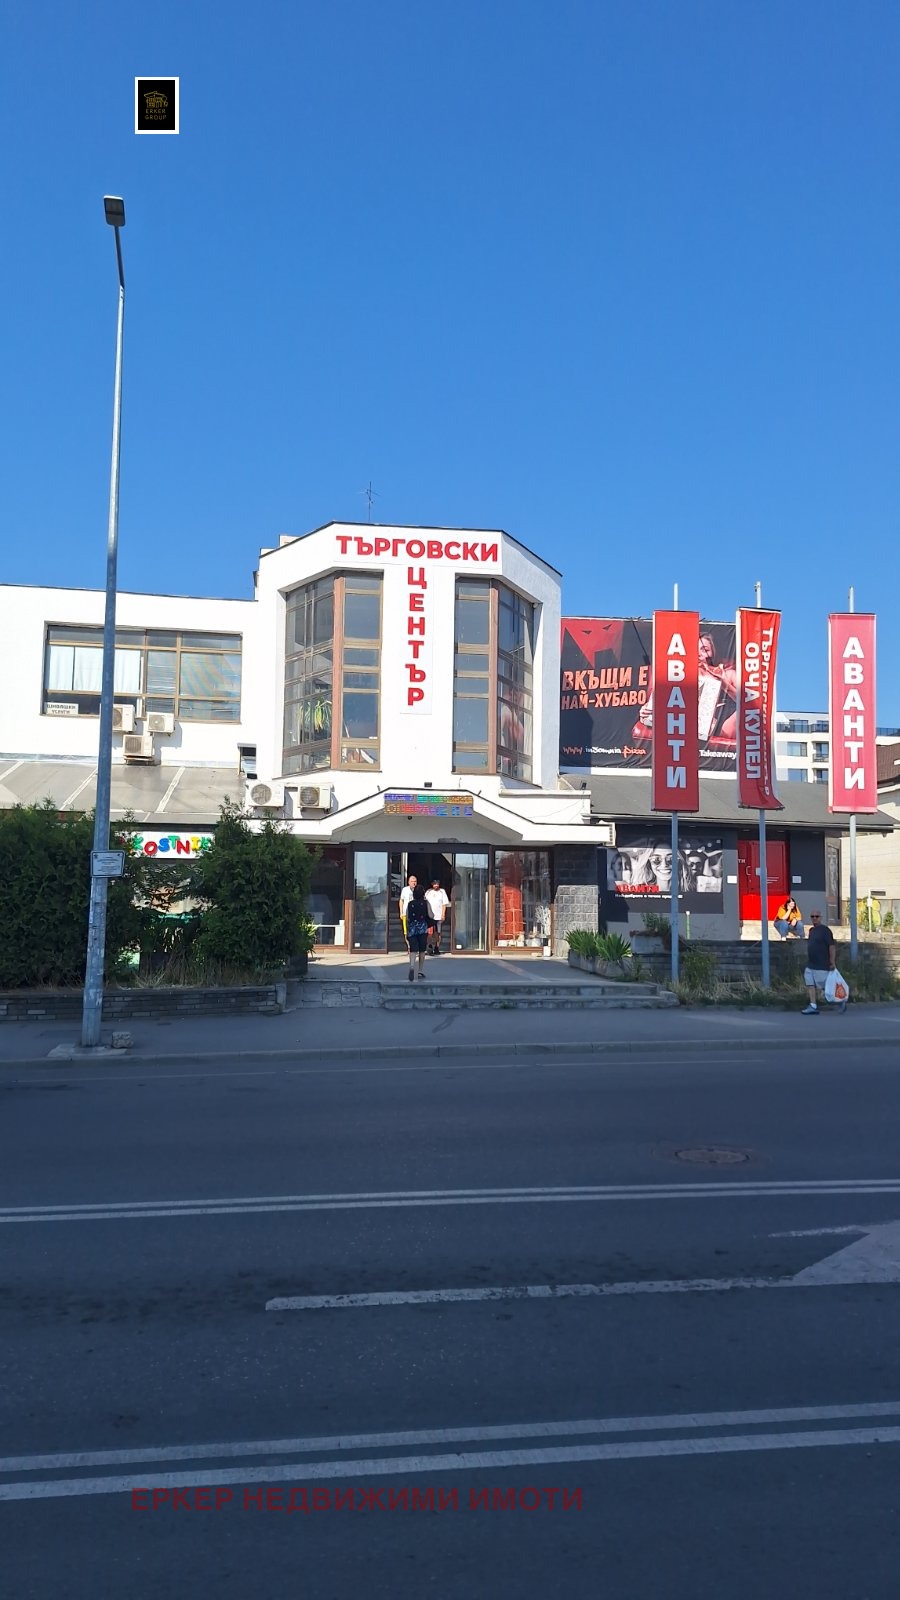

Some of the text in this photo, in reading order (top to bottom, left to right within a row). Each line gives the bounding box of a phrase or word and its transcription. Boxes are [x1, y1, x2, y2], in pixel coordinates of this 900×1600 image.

[336, 535, 498, 562] ТЪРГОВСКИ
[405, 567, 427, 706] ЦЕНТЪР
[561, 690, 647, 710] НАЙ-ХУБАВО
[562, 665, 649, 691] ВКЪЩИ Е
[666, 633, 687, 789] АВАНТИ
[745, 642, 762, 779] ОВЧА КУПЕЛ
[842, 637, 865, 790] АВАНТИ
